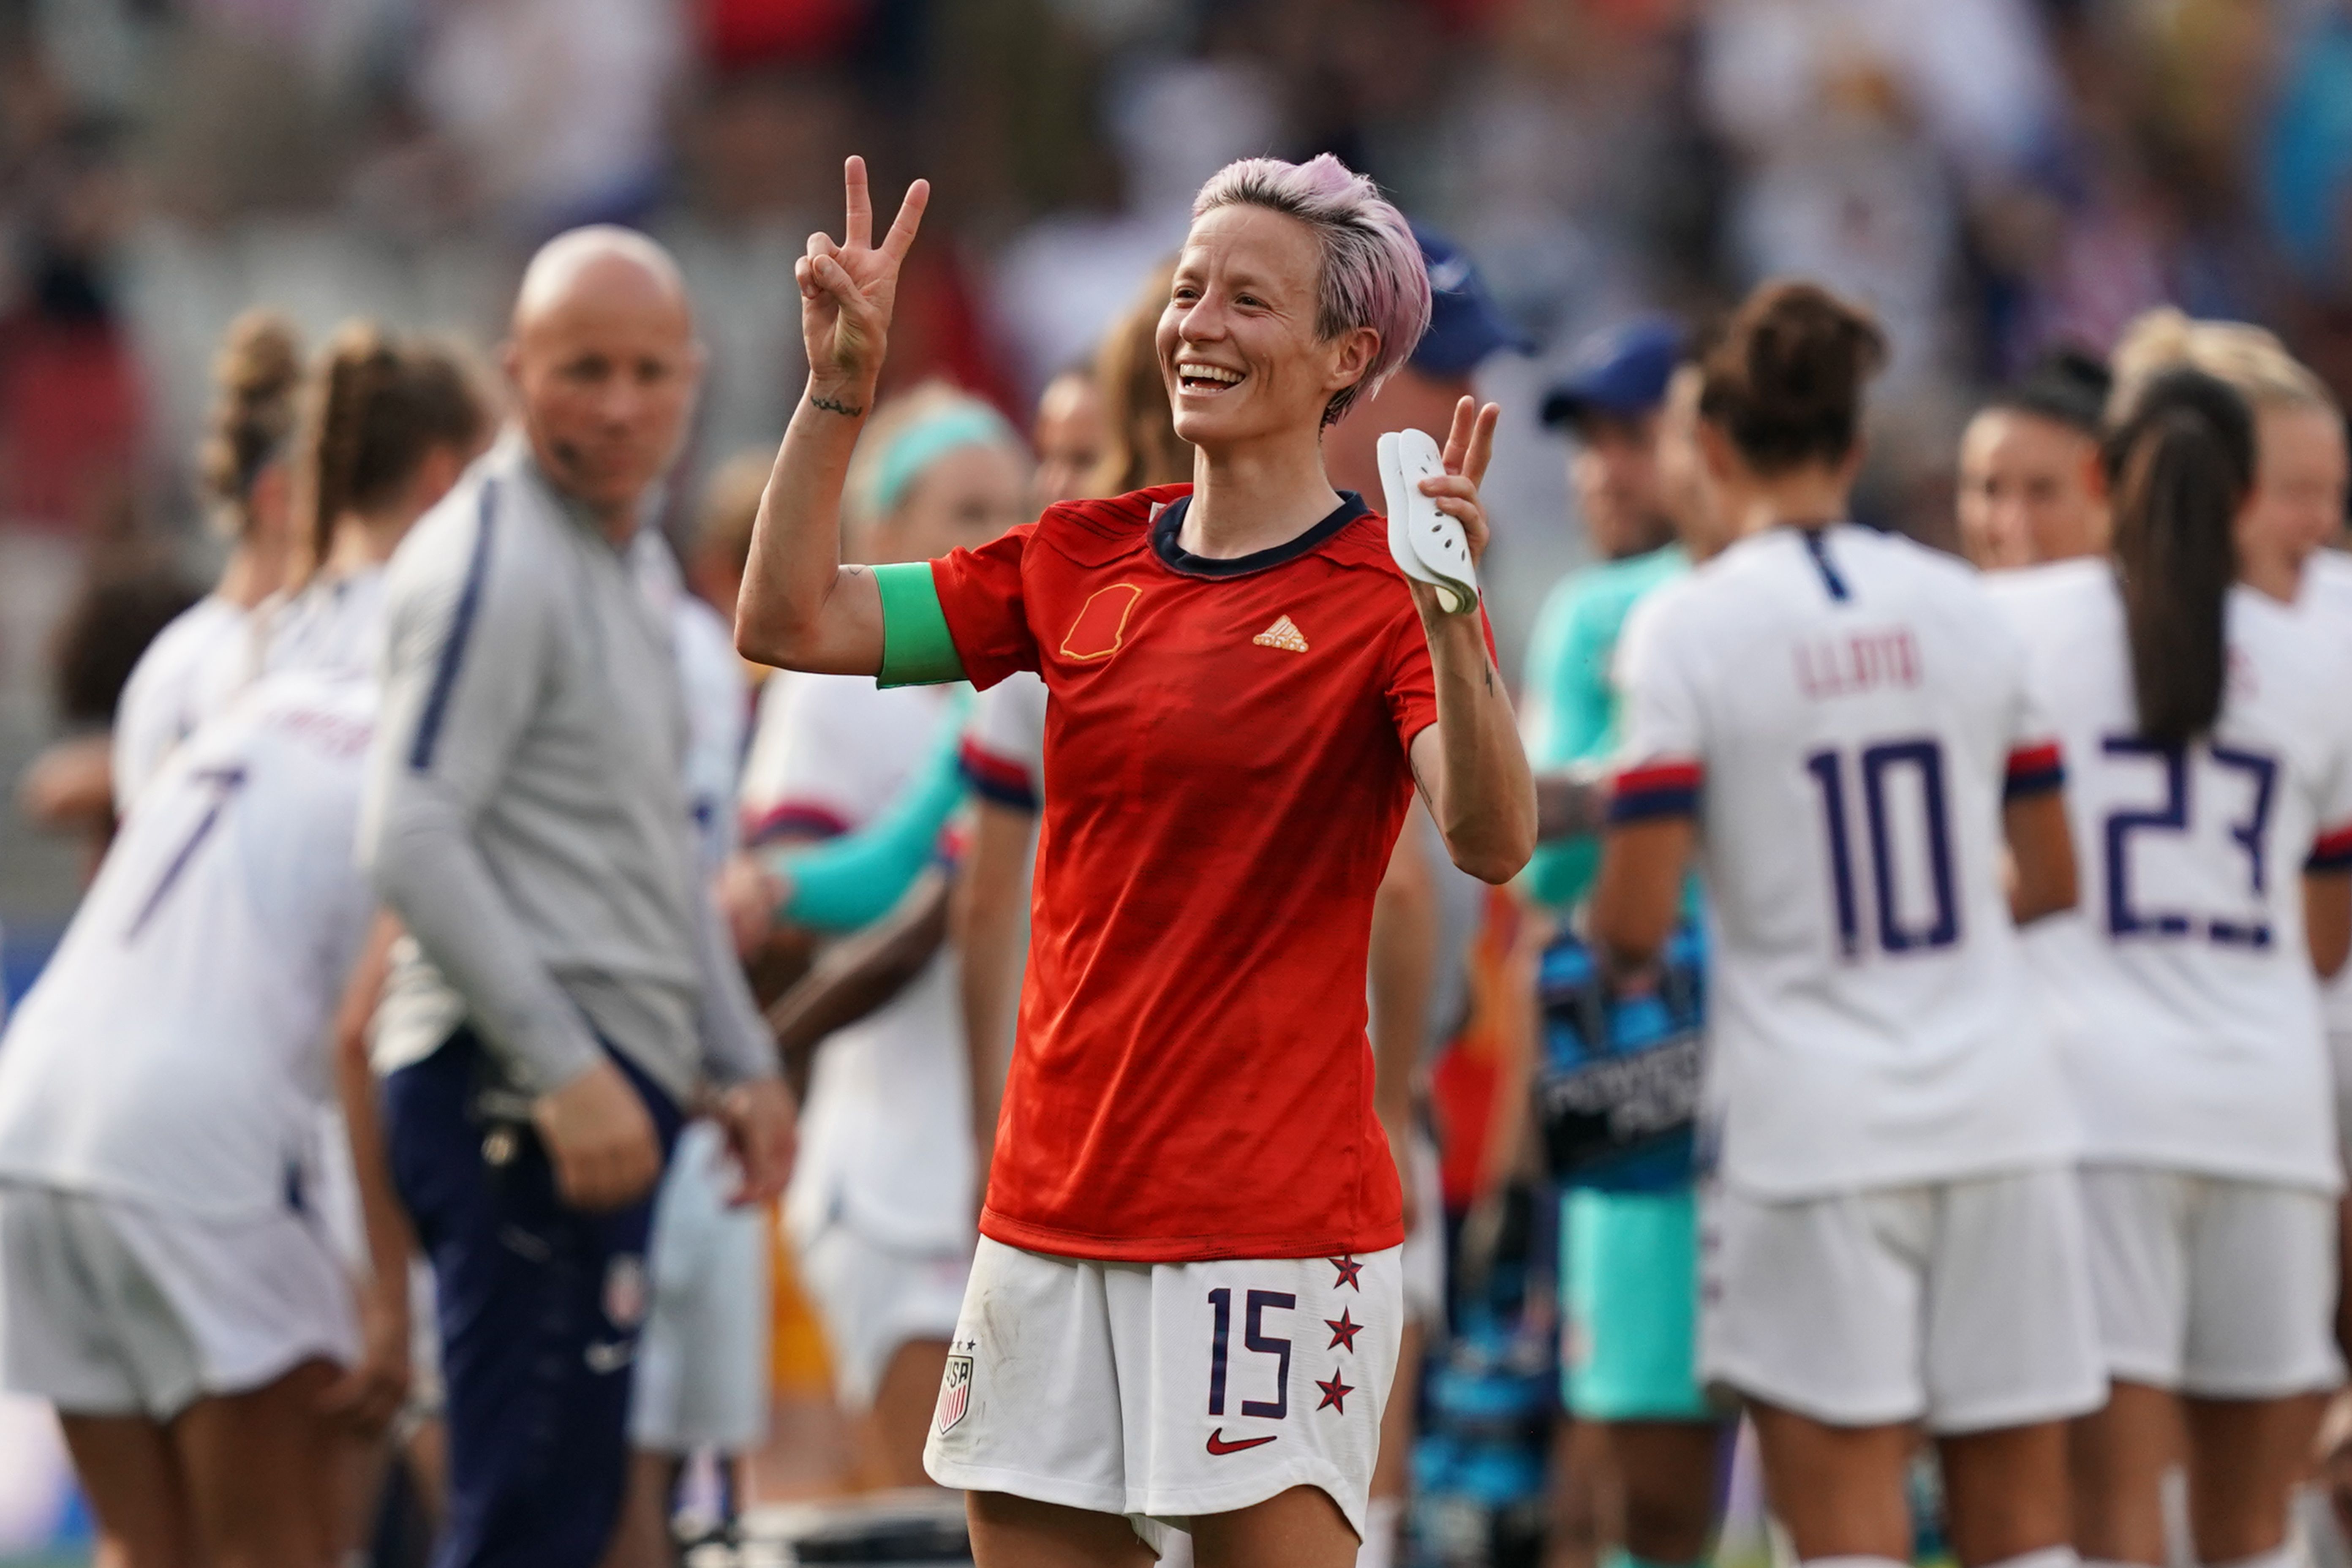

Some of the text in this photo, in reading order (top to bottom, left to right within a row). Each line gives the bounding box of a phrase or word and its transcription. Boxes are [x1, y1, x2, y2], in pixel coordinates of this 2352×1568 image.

[125, 765, 248, 947] 7
[1806, 738, 1960, 961] 10
[2101, 736, 2276, 948] 23
[946, 1361, 969, 1388] USA
[1208, 1288, 1296, 1419] 15
